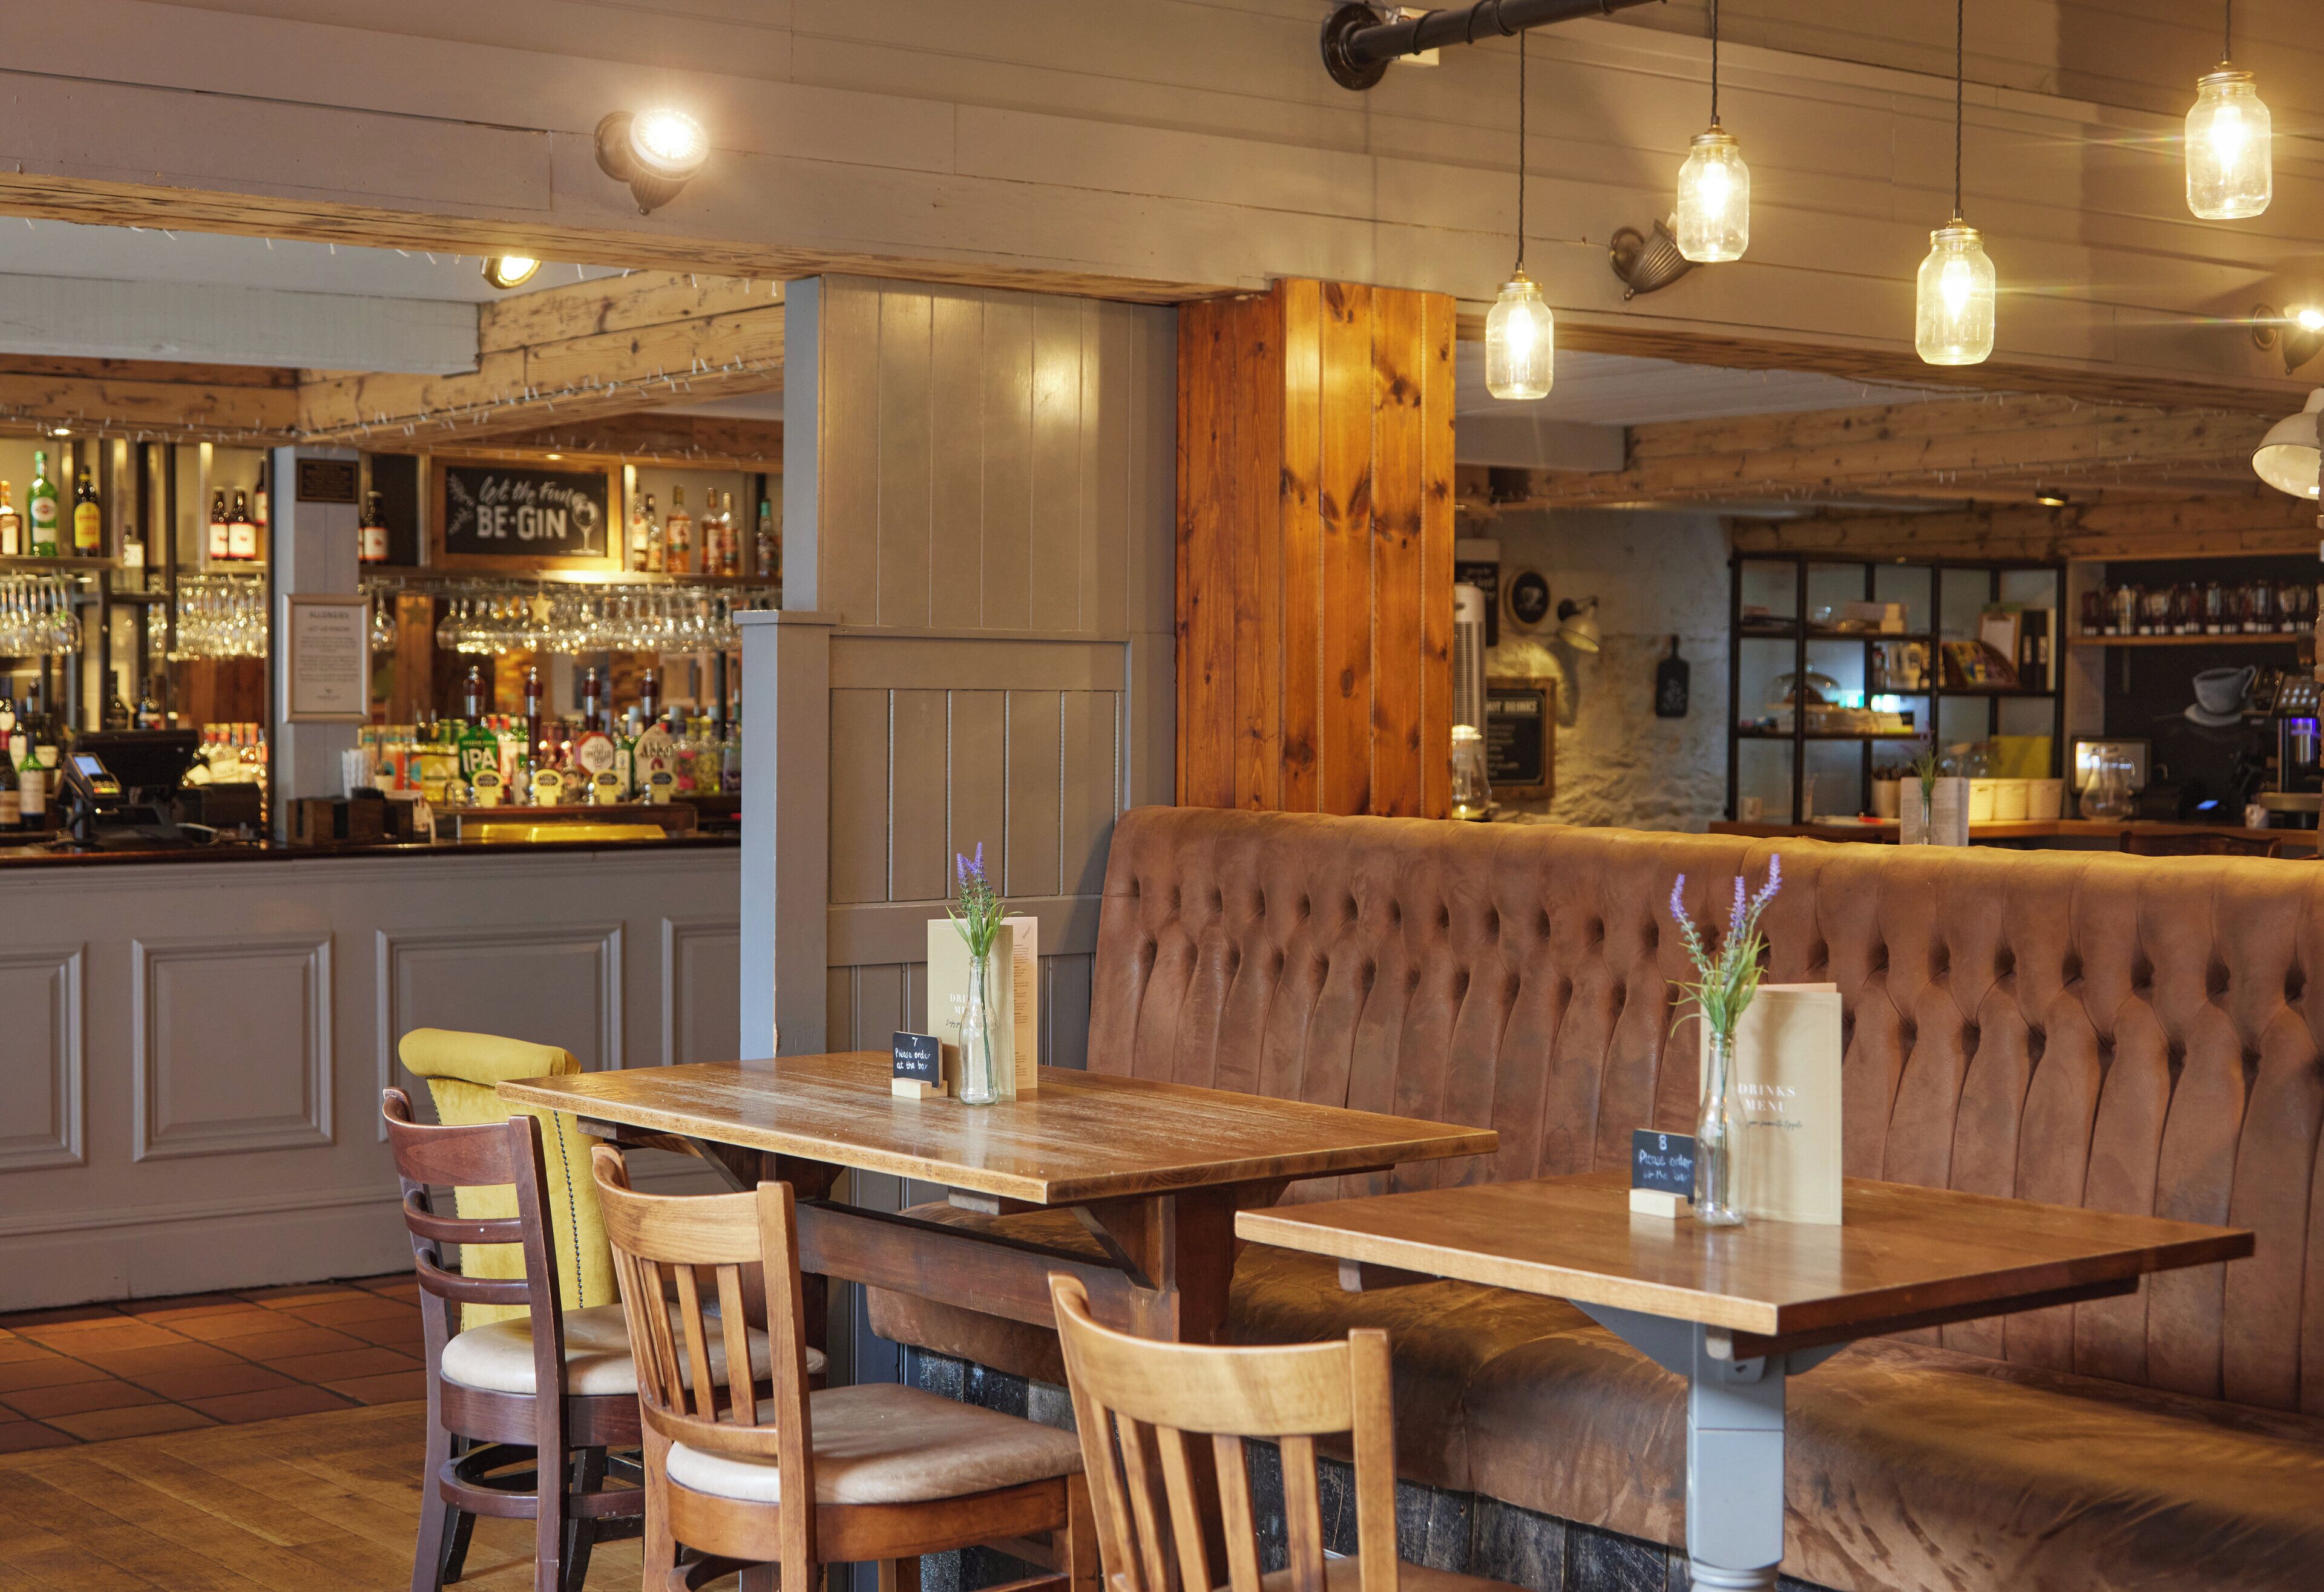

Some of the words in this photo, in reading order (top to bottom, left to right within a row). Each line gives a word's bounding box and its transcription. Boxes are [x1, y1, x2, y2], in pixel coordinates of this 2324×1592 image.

[512, 480, 537, 506] the
[1504, 700, 1538, 712] DRINKS
[462, 747, 497, 773] IPA
[911, 1037, 918, 1047] 7
[895, 1047, 913, 1058] Please
[914, 1049, 931, 1060] order
[896, 1061, 904, 1070] at
[905, 1061, 915, 1070] the
[917, 1060, 928, 1070] bar
[1738, 1083, 1796, 1098] DRINKS
[1746, 1099, 1786, 1113] MENU
[1659, 1134, 1667, 1151] 8
[1639, 1148, 1666, 1167] Please
[1669, 1153, 1693, 1168] order
